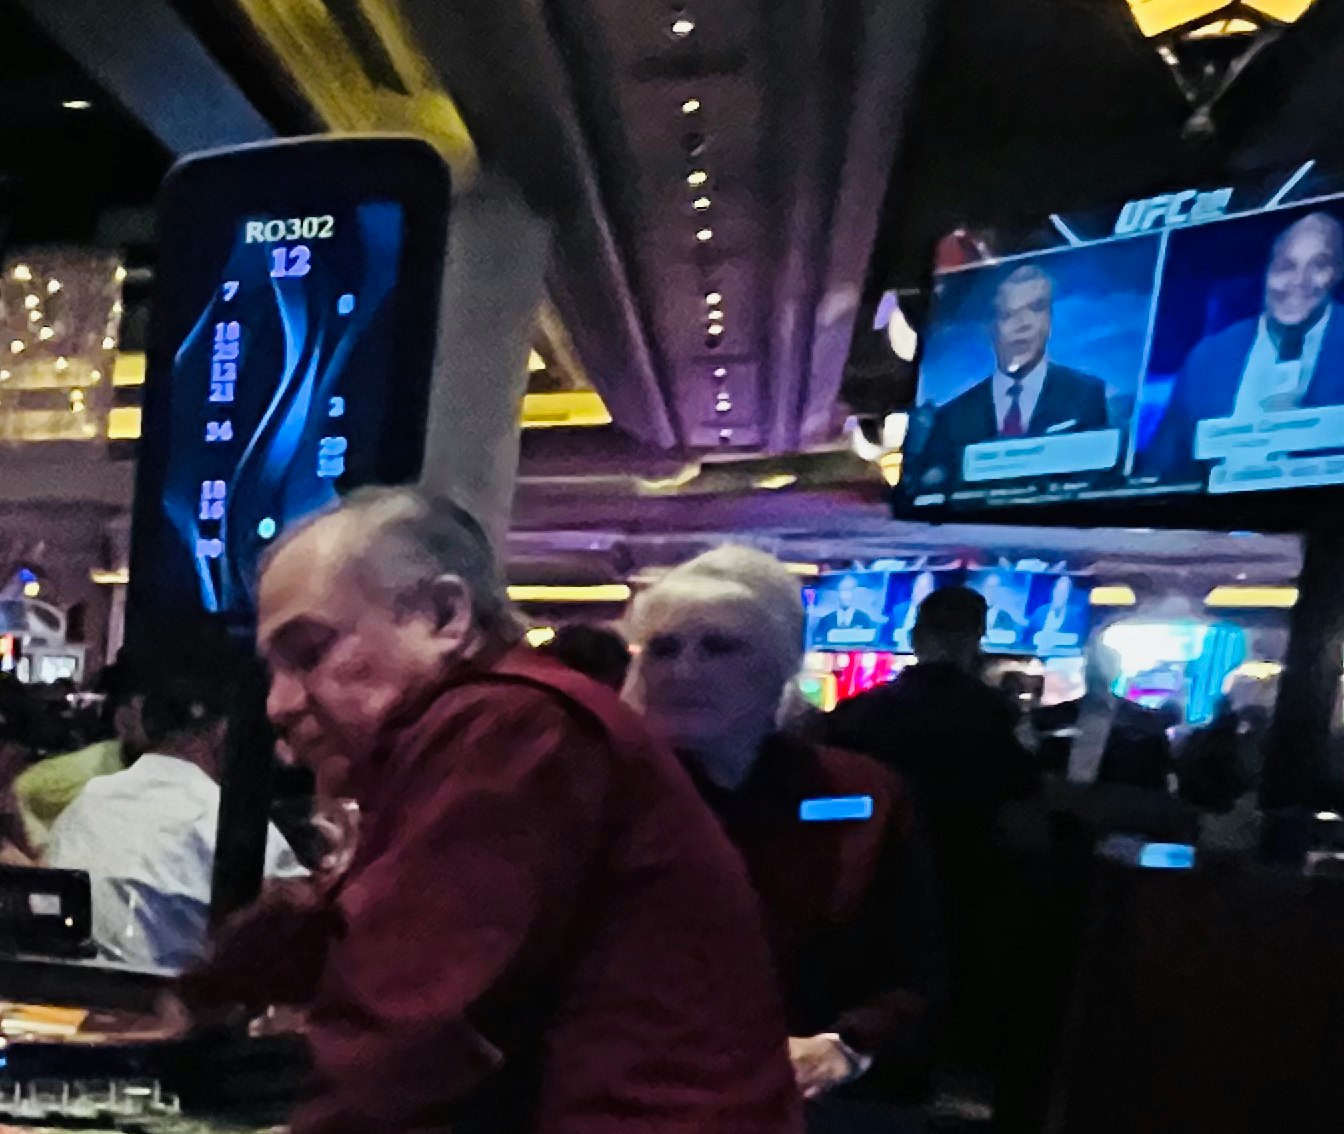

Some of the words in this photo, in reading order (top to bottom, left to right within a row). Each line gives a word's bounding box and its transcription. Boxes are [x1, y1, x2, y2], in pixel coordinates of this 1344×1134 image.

[1114, 190, 1197, 234] UFC
[245, 215, 335, 244] RO302
[270, 244, 312, 278] 12
[223, 280, 240, 301] 7
